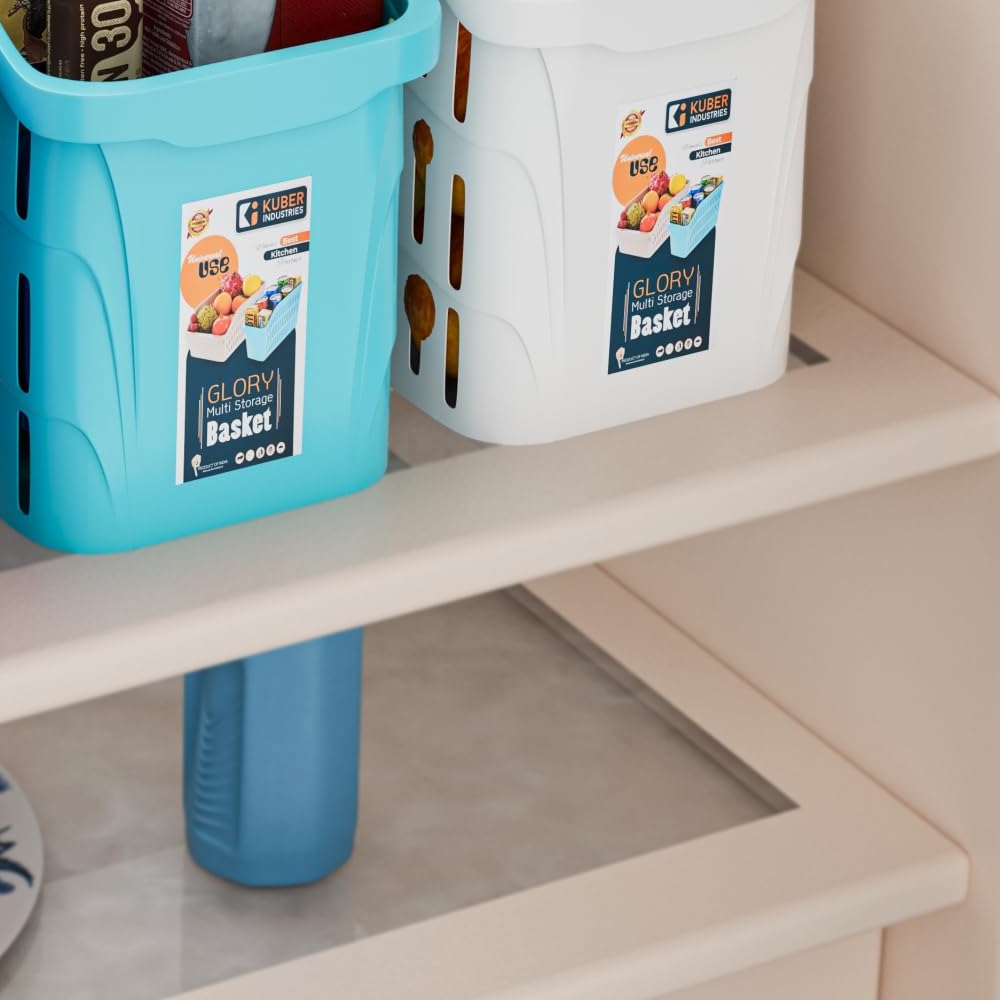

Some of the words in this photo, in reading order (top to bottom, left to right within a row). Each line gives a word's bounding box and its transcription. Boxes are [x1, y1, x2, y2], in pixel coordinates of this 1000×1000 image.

[690, 94, 729, 114] KUBER
[690, 108, 728, 124] INDUSTRIES
[707, 136, 721, 145] Best
[696, 147, 721, 159] Kitchen
[262, 191, 304, 213] KUBER
[262, 206, 304, 223] INDUSTRIES
[282, 235, 298, 244] Best
[271, 247, 298, 259] Kitchen
[633, 266, 695, 299] GLORY
[631, 297, 655, 312] Multi
[657, 289, 693, 306] Storage
[630, 301, 691, 341] Basket
[207, 370, 274, 404] GLORY
[206, 402, 231, 418] Multi
[234, 393, 273, 411] Storage
[206, 406, 273, 447] Basket
